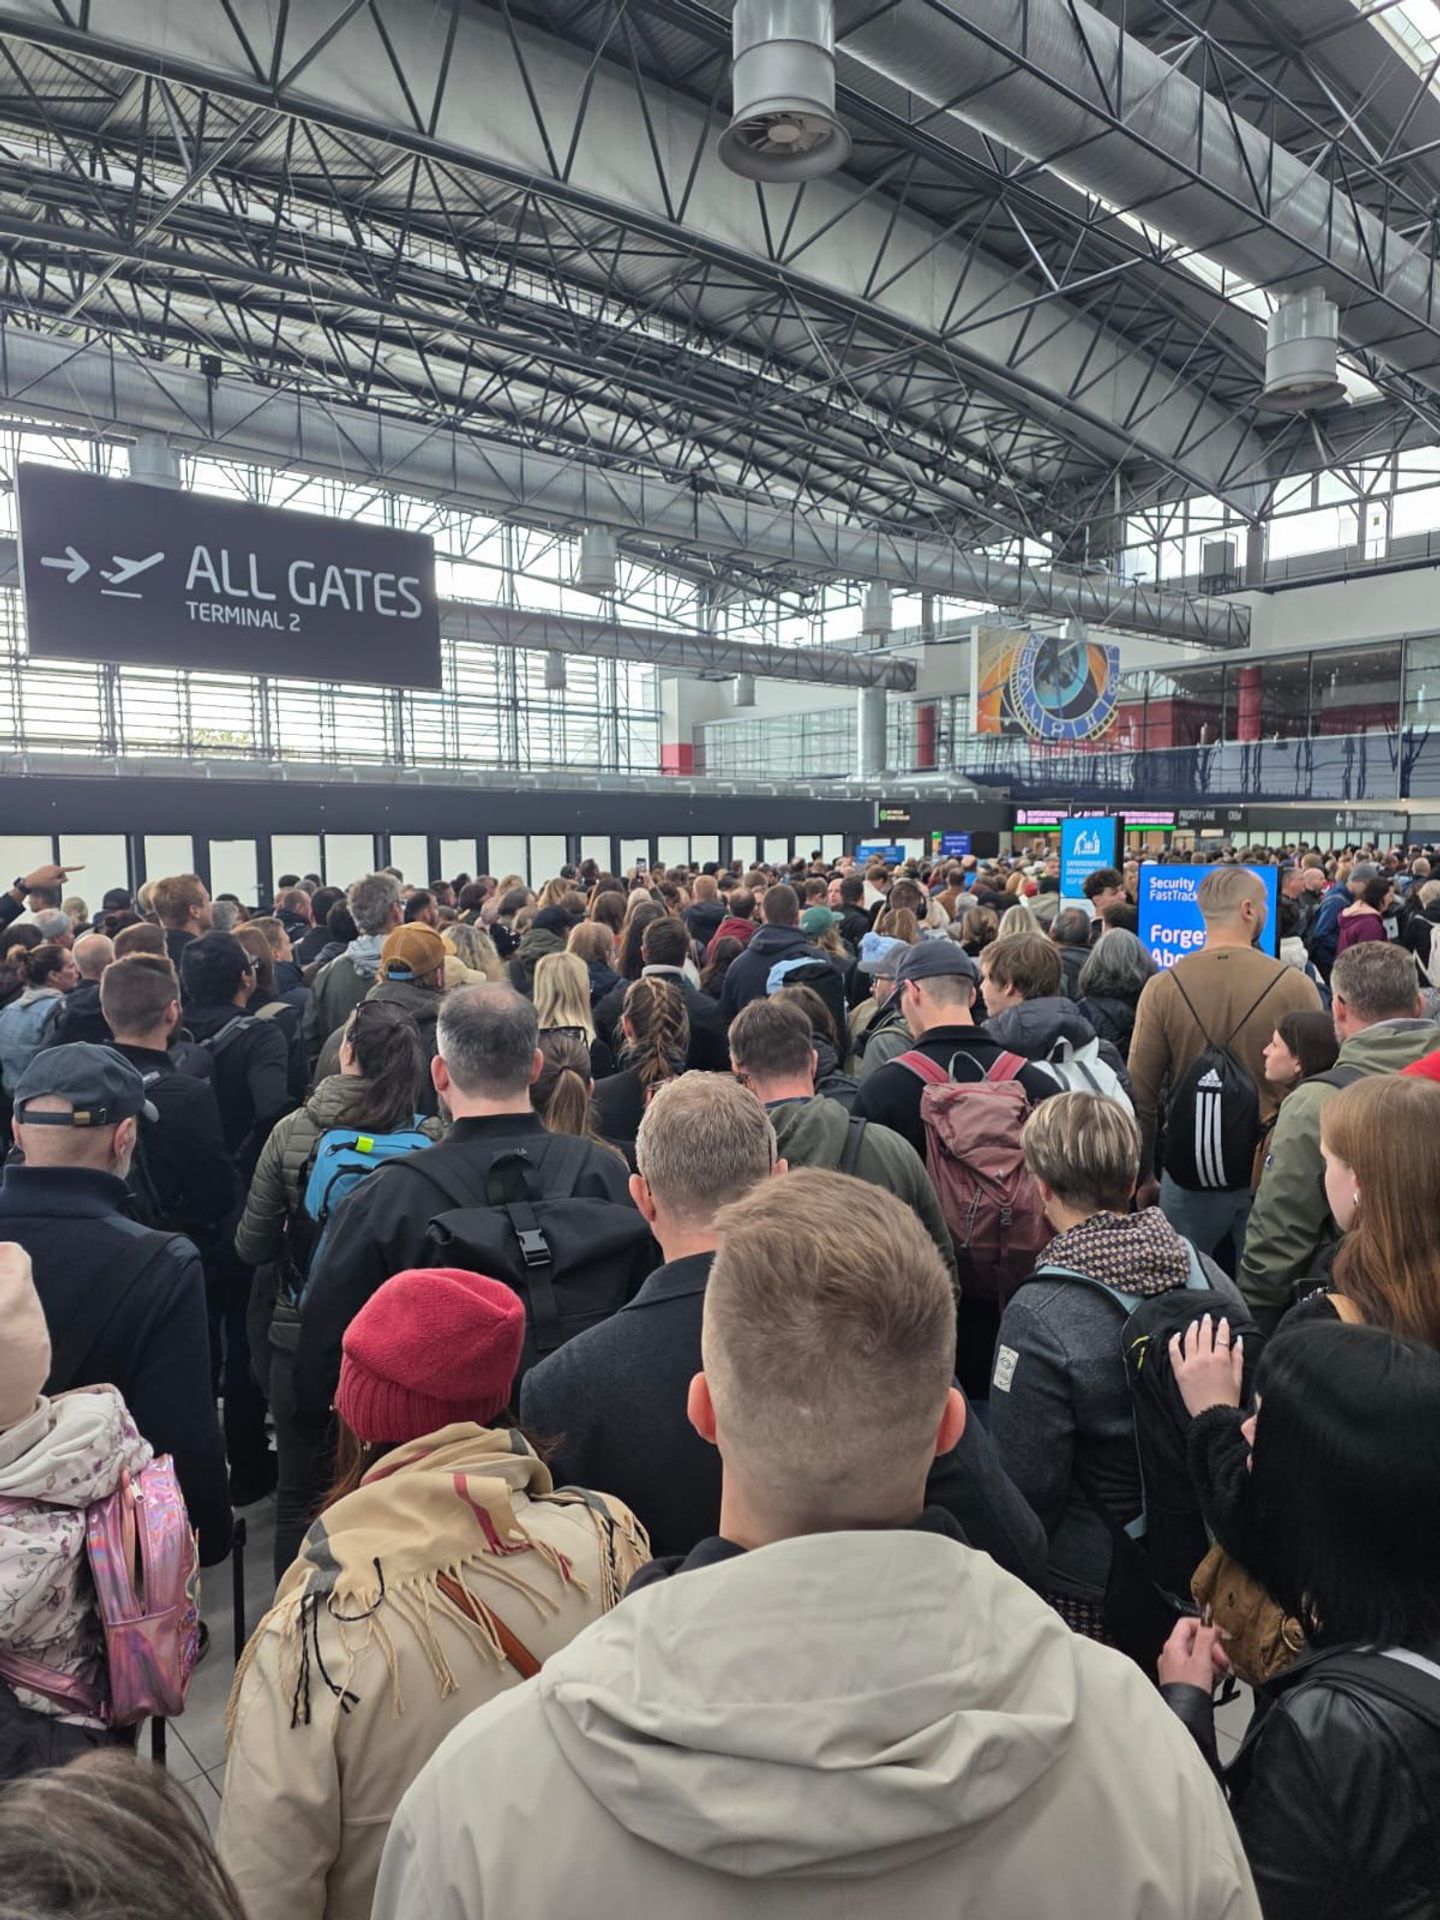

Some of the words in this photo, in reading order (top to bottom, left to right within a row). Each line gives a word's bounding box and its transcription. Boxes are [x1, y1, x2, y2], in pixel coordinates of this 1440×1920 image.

[185, 544, 276, 600] ALL
[288, 560, 422, 618] GATES
[186, 601, 284, 630] TERMINAL
[289, 613, 301, 631] 2
[1149, 877, 1195, 892] Security
[1150, 924, 1207, 949] Forge
